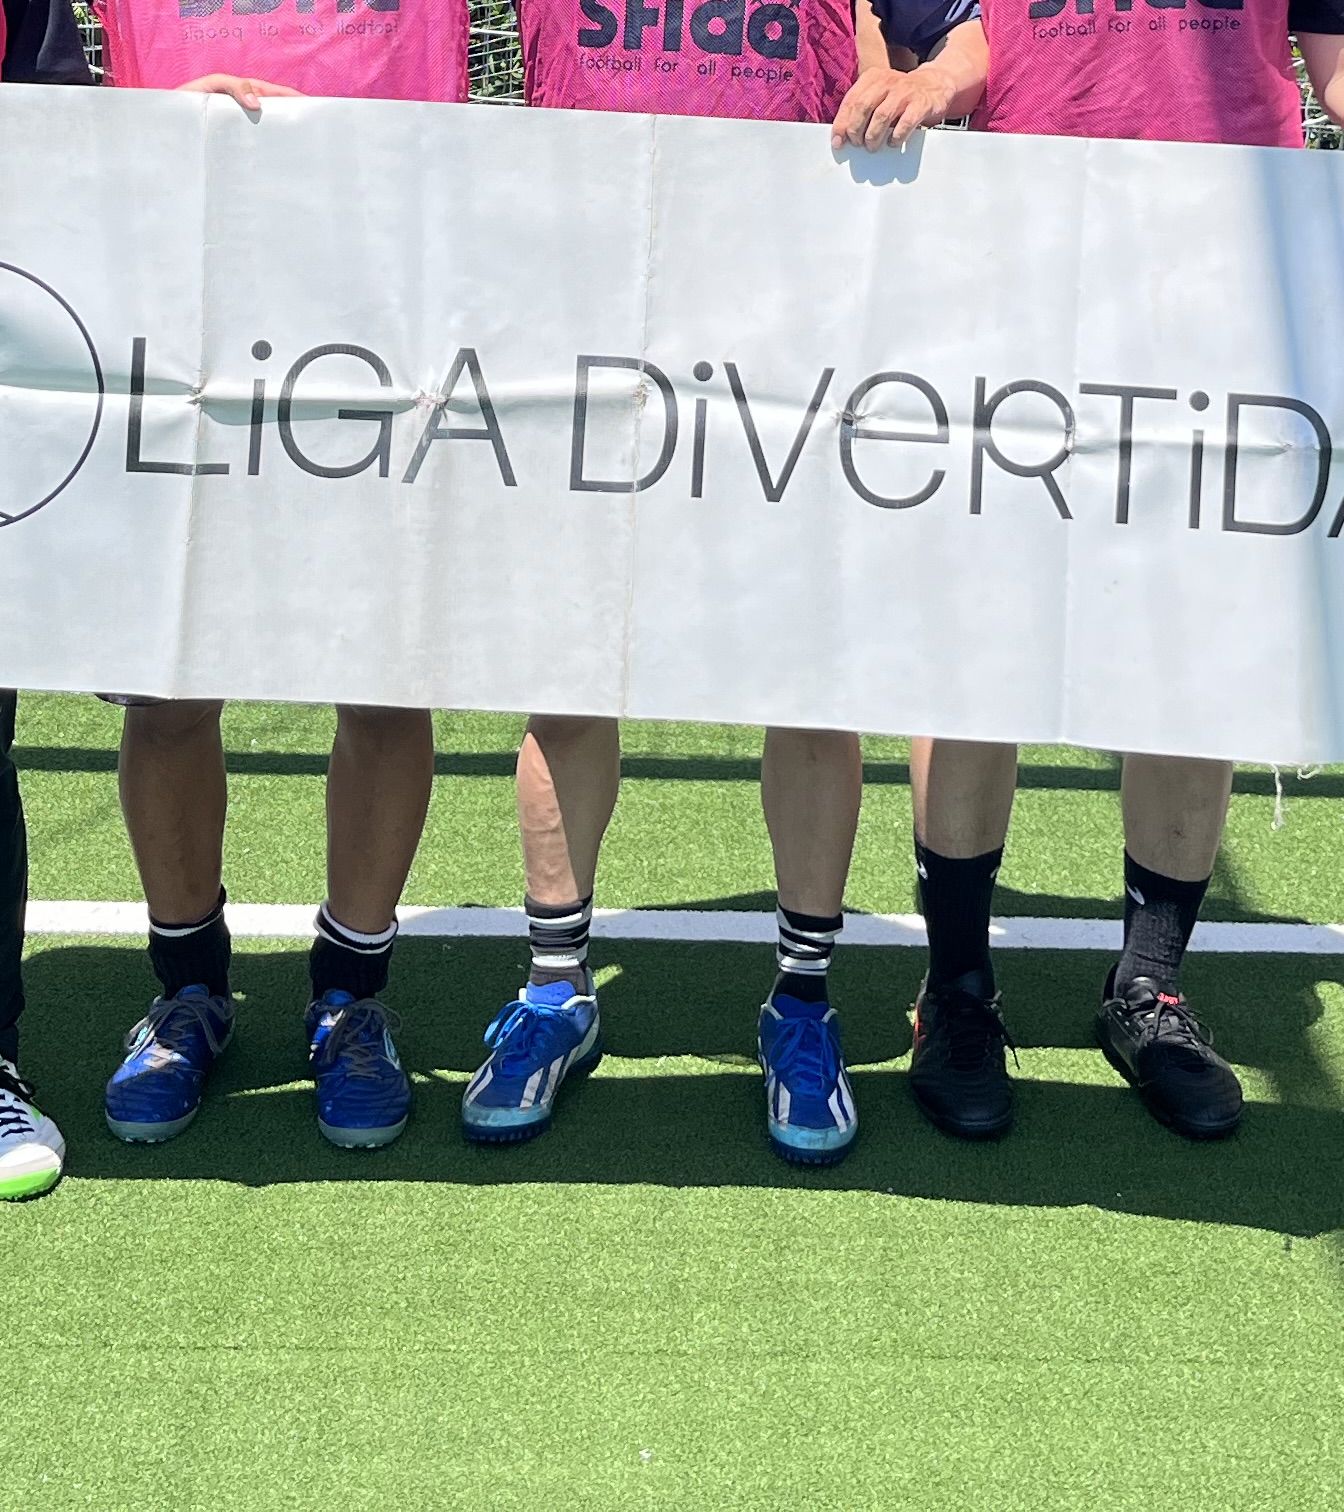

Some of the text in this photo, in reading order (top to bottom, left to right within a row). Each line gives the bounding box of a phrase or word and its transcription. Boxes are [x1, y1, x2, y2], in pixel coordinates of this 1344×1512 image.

[1032, 15, 1241, 40] football for all people
[579, 53, 794, 84] football for all people
